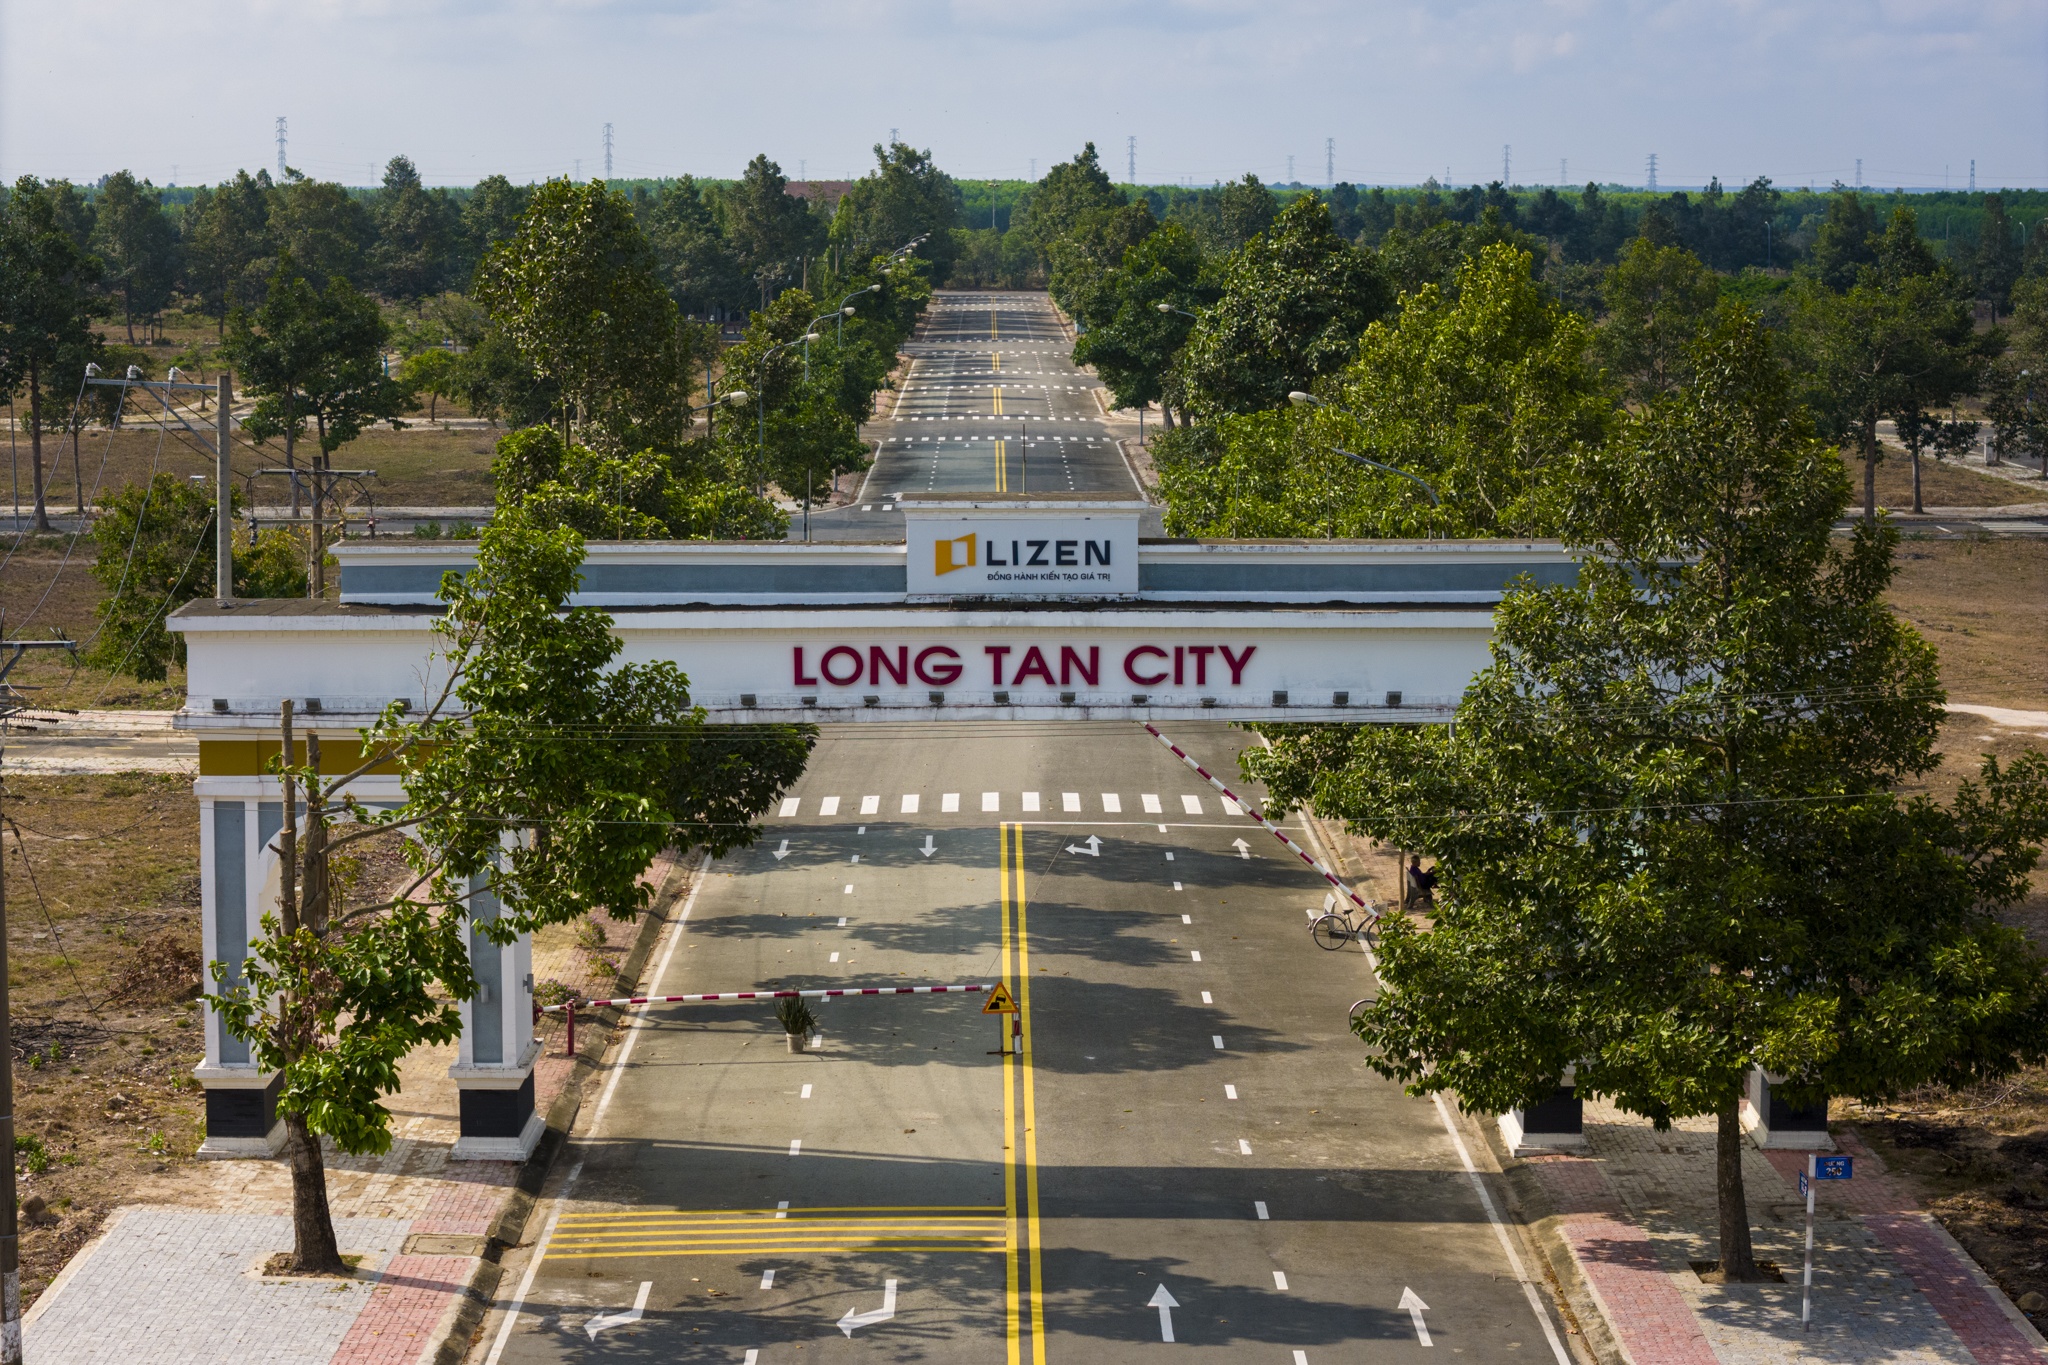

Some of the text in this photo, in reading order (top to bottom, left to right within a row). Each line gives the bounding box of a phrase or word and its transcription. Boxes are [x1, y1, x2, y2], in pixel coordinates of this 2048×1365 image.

[986, 540, 1111, 566] LIZEN
[1014, 571, 1038, 580] HÀNH
[1040, 570, 1060, 580] KIẾN
[1062, 572, 1079, 582] TẠO
[1080, 572, 1095, 580] GIÁ
[1097, 572, 1111, 582] TRỊ
[793, 645, 1257, 686] LONG TAN CITY
